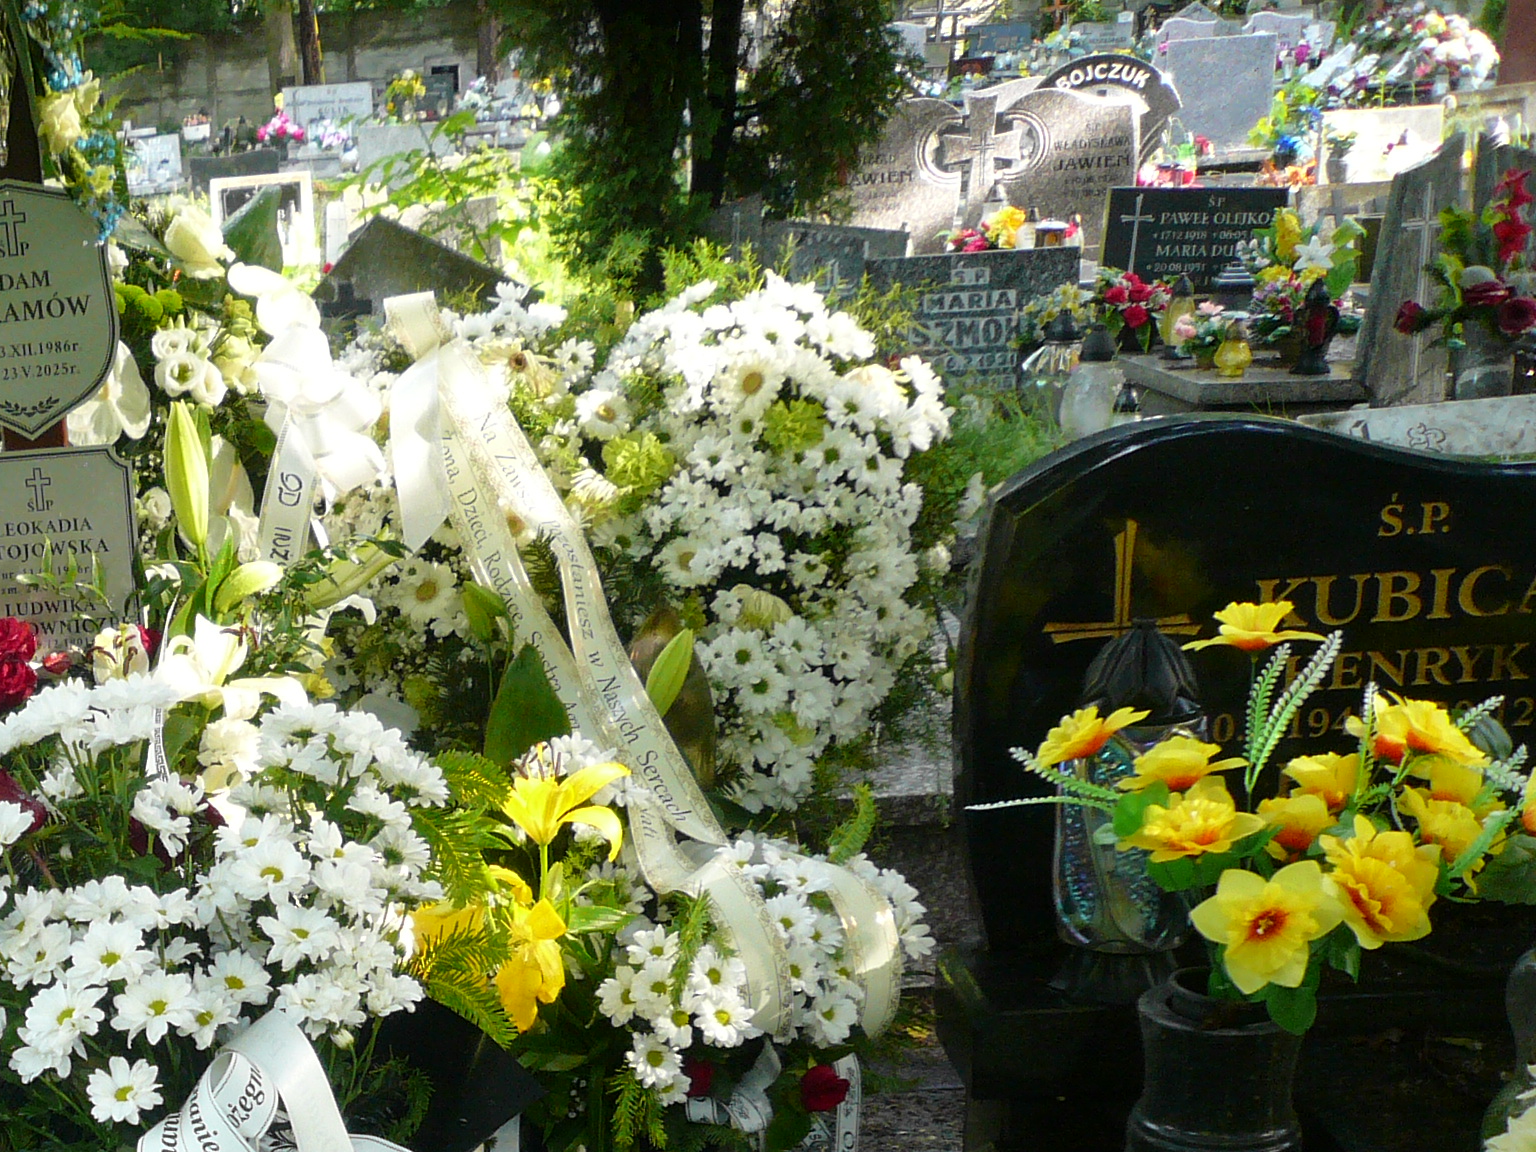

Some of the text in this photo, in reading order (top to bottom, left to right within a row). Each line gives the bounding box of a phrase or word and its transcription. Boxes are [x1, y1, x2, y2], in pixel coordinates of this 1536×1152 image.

[1055, 63, 1150, 89] BOJCZUK
[1211, 244, 1236, 257] DU
[5, 599, 97, 617] LUDWIKA
[596, 676, 647, 744] Naszych
[636, 750, 695, 823] Sercach
